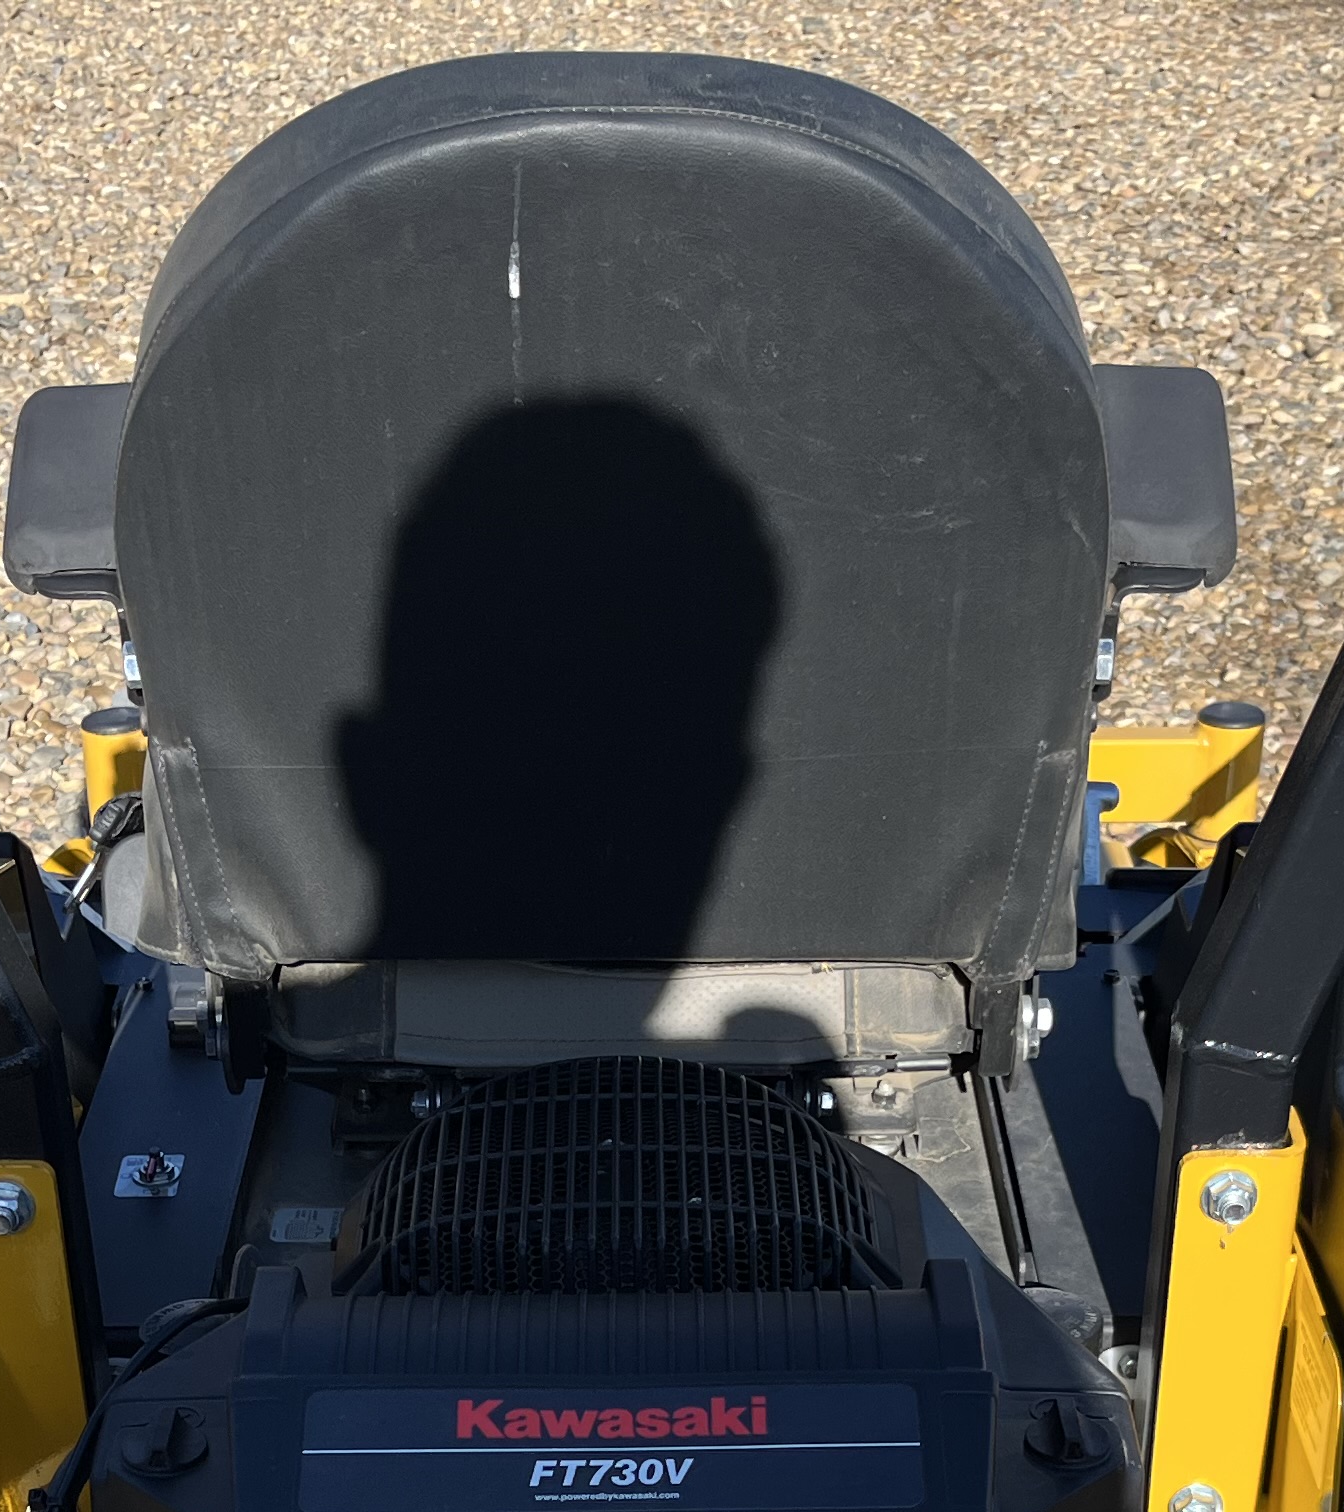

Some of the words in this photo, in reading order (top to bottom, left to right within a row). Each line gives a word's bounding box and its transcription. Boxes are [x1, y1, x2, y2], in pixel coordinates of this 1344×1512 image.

[456, 1395, 768, 1439] Kawasaki
[529, 1458, 694, 1487] FT730V
[534, 1491, 680, 1502] www.poweredbykawasaki.com
